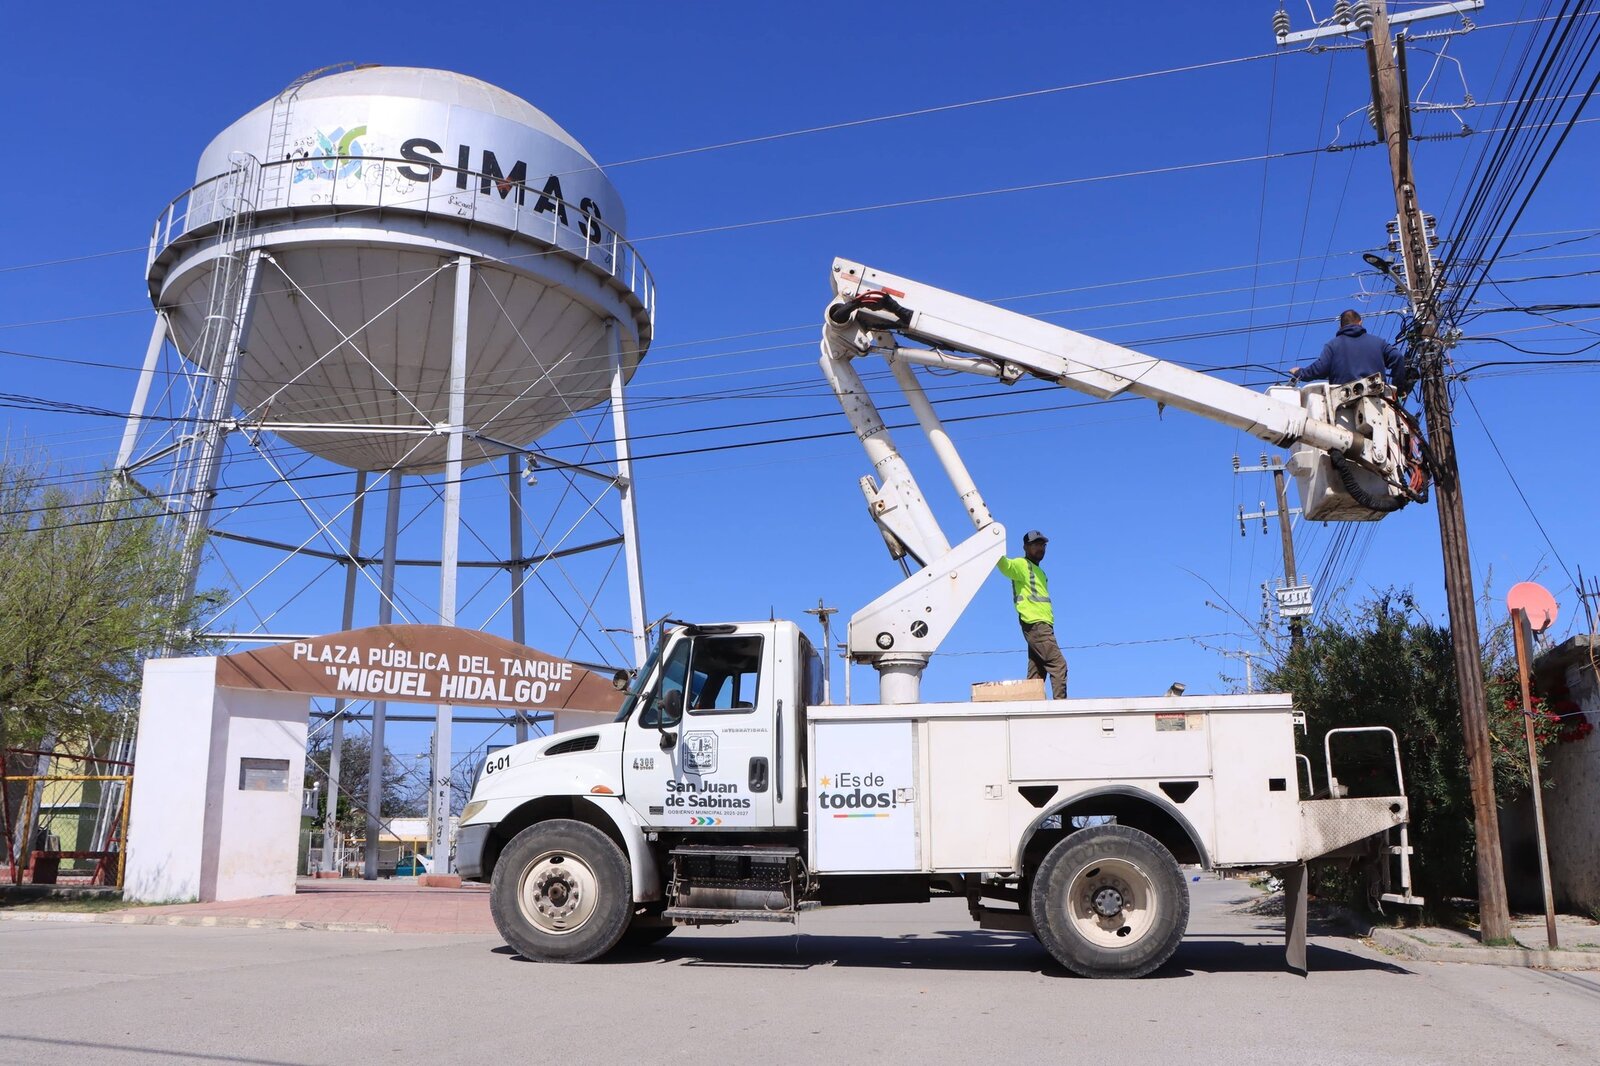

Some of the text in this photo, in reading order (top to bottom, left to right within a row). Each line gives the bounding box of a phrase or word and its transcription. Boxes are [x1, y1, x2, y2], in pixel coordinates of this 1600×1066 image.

[397, 138, 602, 244] SIMAS
[293, 642, 573, 681] PLAZA PÚBLICA DEL TANQUE
[325, 666, 561, 704] "MIGUEL HIDALGO"
[486, 754, 510, 775] G-01
[666, 780, 738, 793] San Juan
[835, 772, 884, 788] ¡Es de
[665, 794, 751, 808] de Sabinas
[818, 788, 897, 809] todos!
